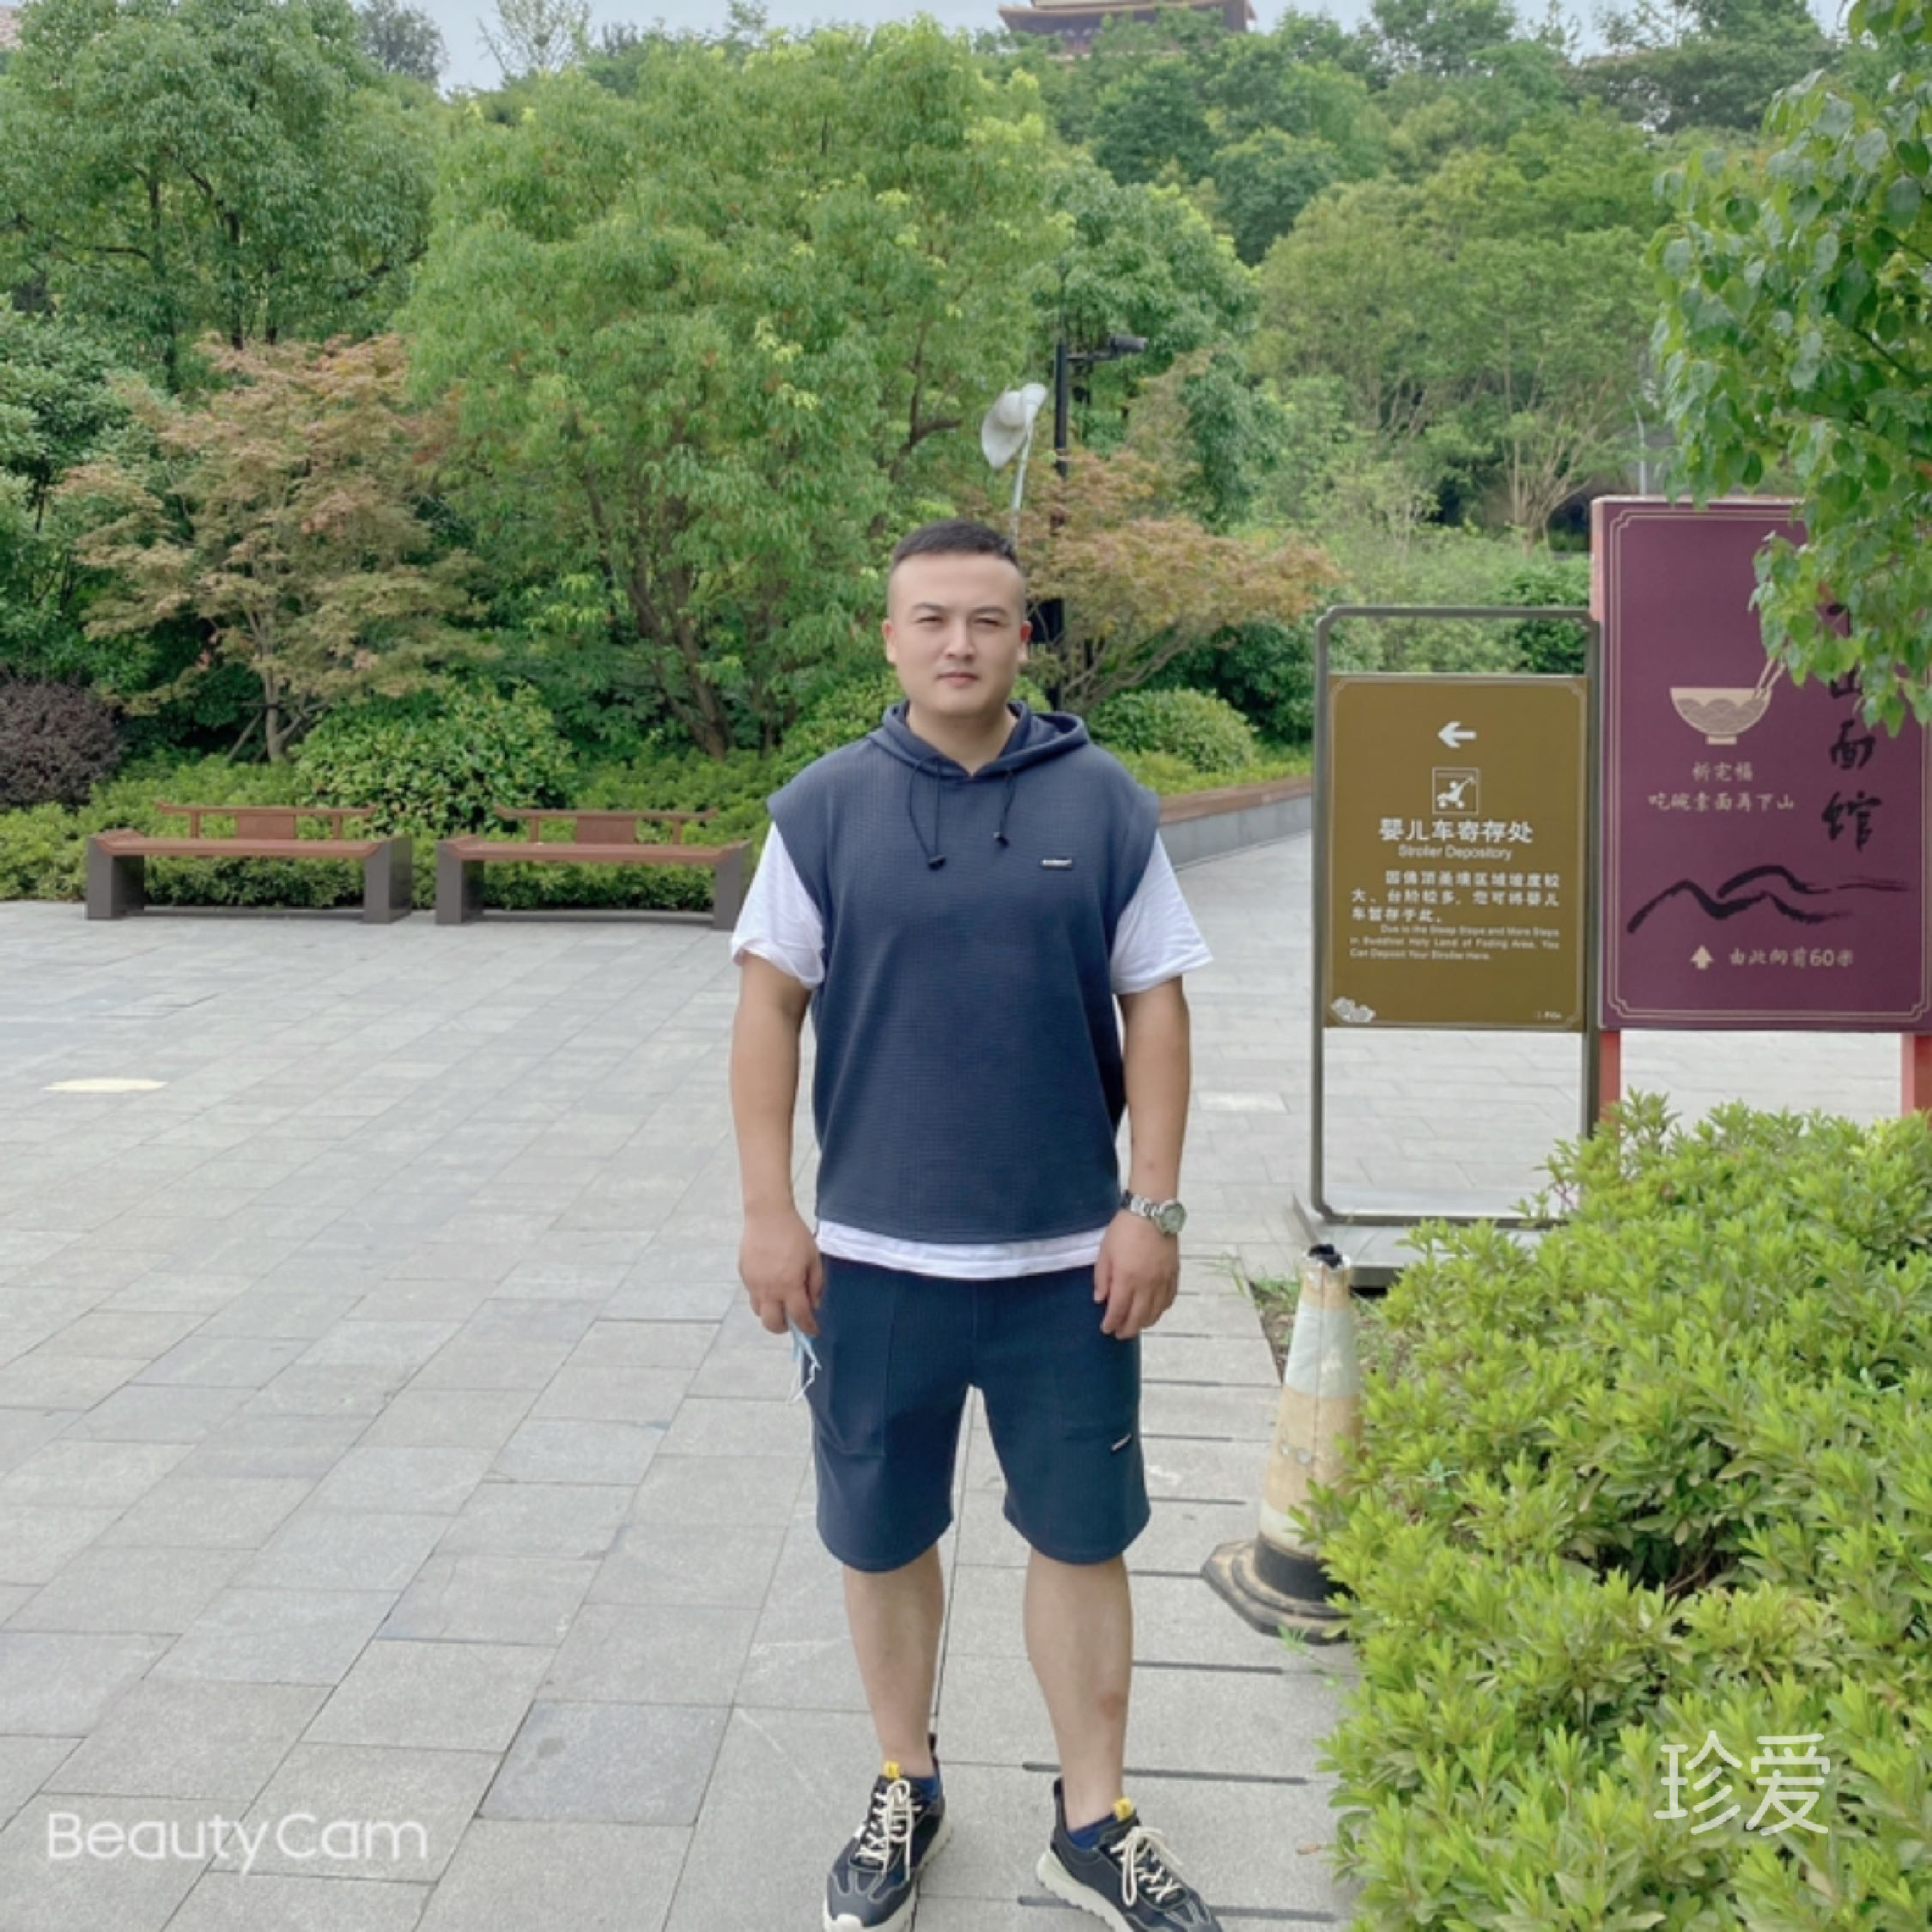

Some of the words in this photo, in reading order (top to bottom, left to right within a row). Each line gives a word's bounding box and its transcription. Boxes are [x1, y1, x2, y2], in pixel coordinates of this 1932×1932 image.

[1648, 790, 1795, 812] 吃碗素面再下山
[1379, 817, 1534, 843] 婴儿车寄存处
[1398, 844, 1443, 859] Stroller
[1445, 844, 1512, 861] Depository
[1729, 947, 1854, 968] 由此向前60米
